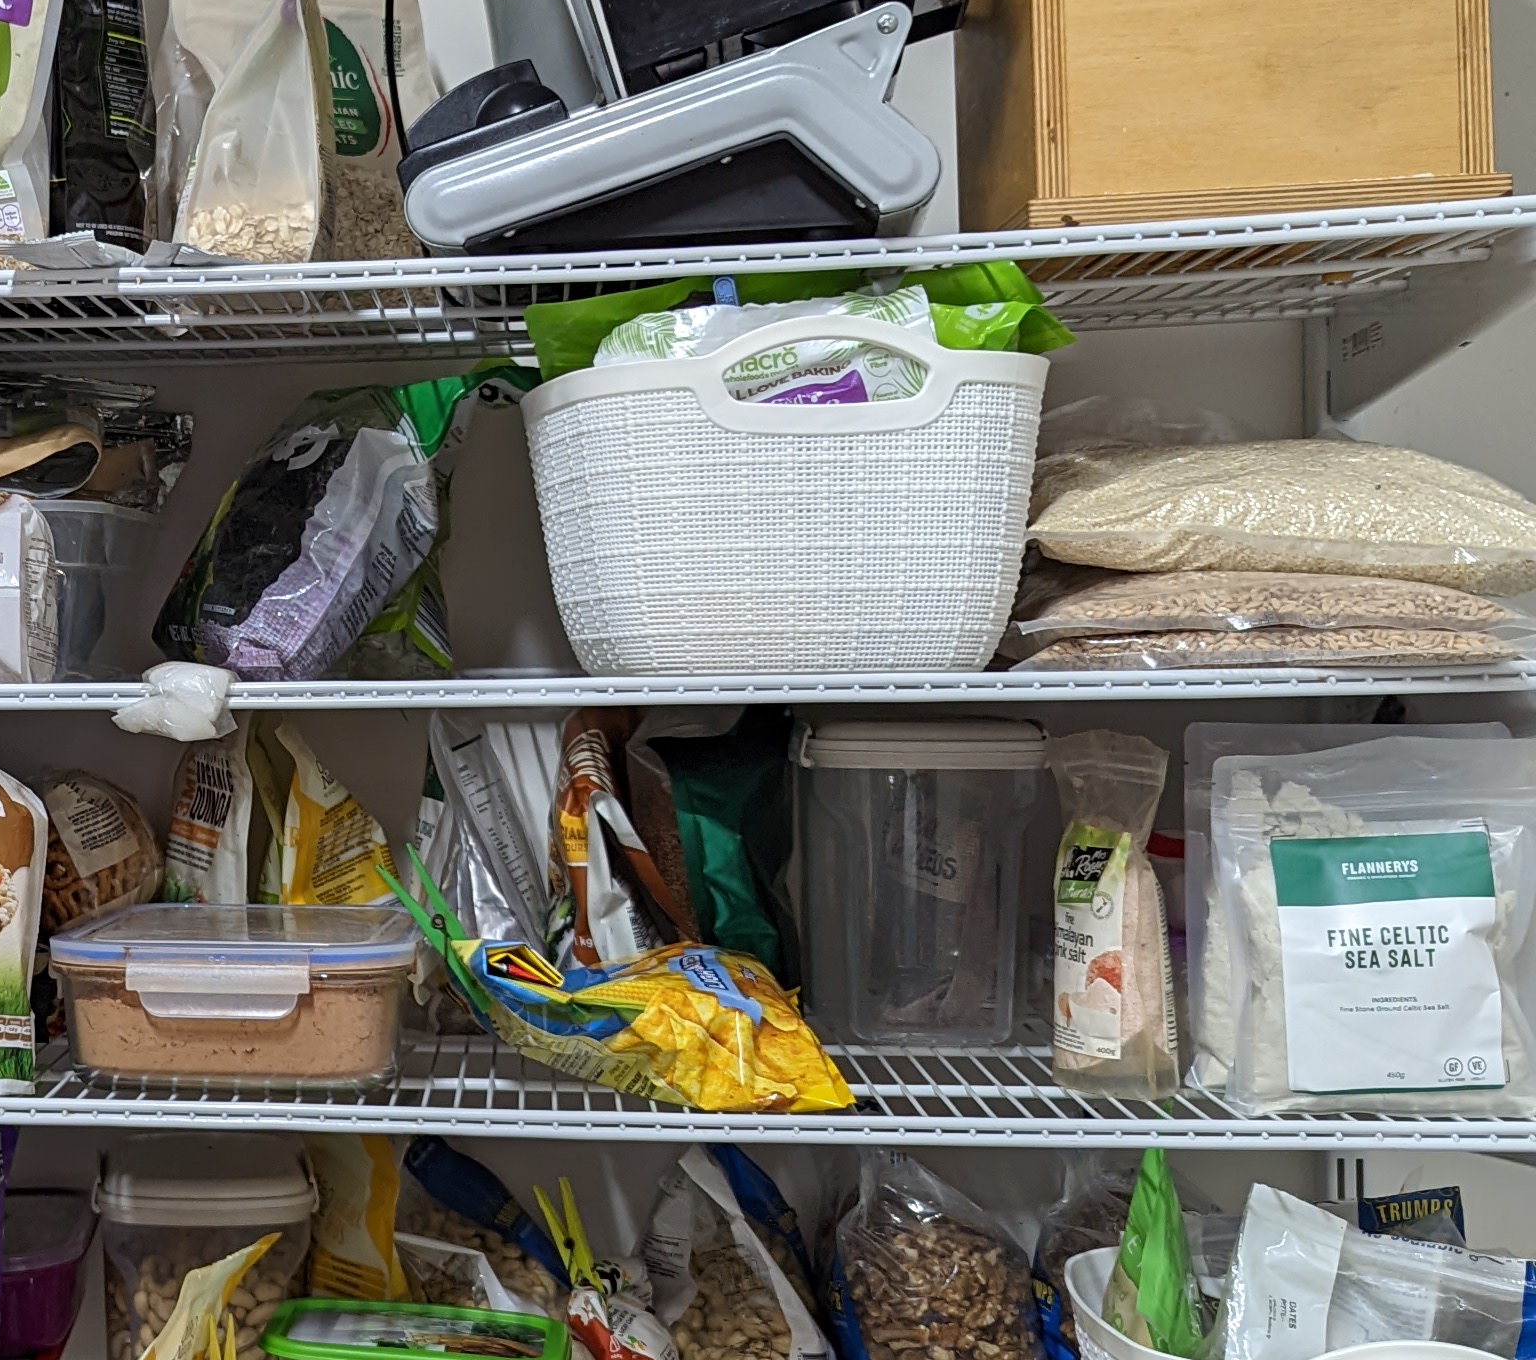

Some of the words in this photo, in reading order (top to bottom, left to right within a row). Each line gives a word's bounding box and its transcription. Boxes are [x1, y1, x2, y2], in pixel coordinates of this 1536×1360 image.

[747, 375, 791, 397] LOVE
[189, 786, 233, 830] QUINOA
[1342, 859, 1419, 877] FLANNERYS
[1327, 927, 1373, 948] FINE
[1380, 924, 1451, 947] CELTIC
[1069, 947, 1088, 965] salt
[1344, 949, 1382, 970] SEA
[1388, 948, 1437, 969] SALT
[1375, 1198, 1453, 1224] TRUMPS
[1288, 1300, 1298, 1330] DATES
